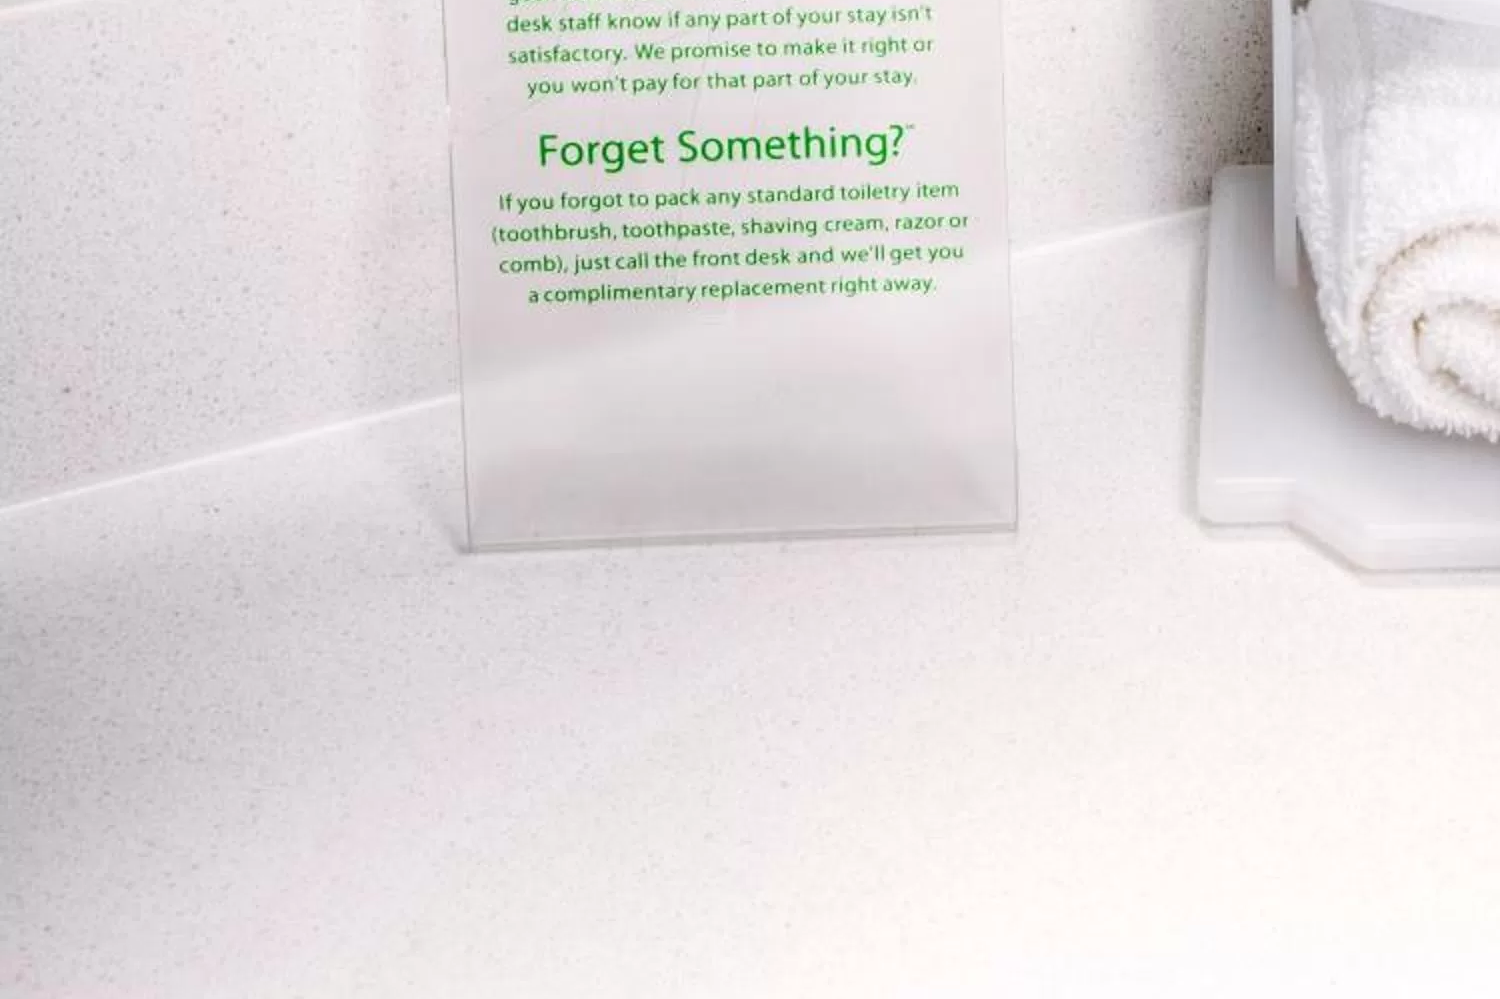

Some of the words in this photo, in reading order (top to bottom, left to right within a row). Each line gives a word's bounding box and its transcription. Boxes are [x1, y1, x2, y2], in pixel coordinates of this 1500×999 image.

[507, 15, 552, 32] desk
[559, 13, 600, 31] staff
[608, 13, 661, 29] know
[668, 11, 680, 27] if
[685, 15, 720, 31] any
[726, 11, 767, 29] part
[773, 9, 796, 25] of
[797, 11, 841, 28] your
[848, 9, 886, 25] stay
[892, 6, 931, 22] isn't
[509, 45, 628, 65] satisfactory.
[635, 44, 664, 59] We
[671, 45, 750, 63] promise
[757, 43, 777, 56] to
[784, 39, 836, 55] make
[842, 38, 856, 53] it
[862, 37, 907, 57] right
[913, 40, 932, 52] or
[528, 81, 564, 98] you
[572, 76, 627, 93] won't
[632, 79, 668, 95] pay
[673, 73, 700, 89] for
[707, 73, 746, 89] that
[753, 73, 792, 90] part
[799, 69, 821, 86] of
[824, 73, 868, 89] your
[874, 70, 918, 87] stay.
[540, 135, 664, 173] Forget
[499, 194, 515, 210] If
[517, 198, 554, 214] you
[561, 193, 623, 212] forgot
[629, 193, 648, 207] to
[655, 189, 700, 209] pack
[706, 192, 741, 207] any
[748, 185, 834, 203] standard
[841, 185, 910, 201] toiletry
[917, 185, 959, 198] item
[492, 223, 616, 243] (toothbrush,
[623, 221, 734, 239] toothpaste,
[742, 218, 817, 237] shaving
[825, 218, 888, 232] cream,
[895, 217, 944, 230] razor
[949, 217, 967, 228] or
[500, 255, 568, 273] comb),
[574, 256, 610, 275] just
[616, 253, 648, 269] call
[655, 252, 686, 267] the
[693, 251, 739, 266] front
[746, 249, 790, 265] desk
[798, 247, 834, 263] and
[841, 245, 884, 262] we'll
[890, 247, 921, 265] get
[928, 247, 963, 263] you
[529, 291, 538, 303] a
[544, 285, 696, 303] complimentary
[701, 281, 824, 301] replacement
[832, 277, 877, 297] right
[883, 279, 936, 294] away.
